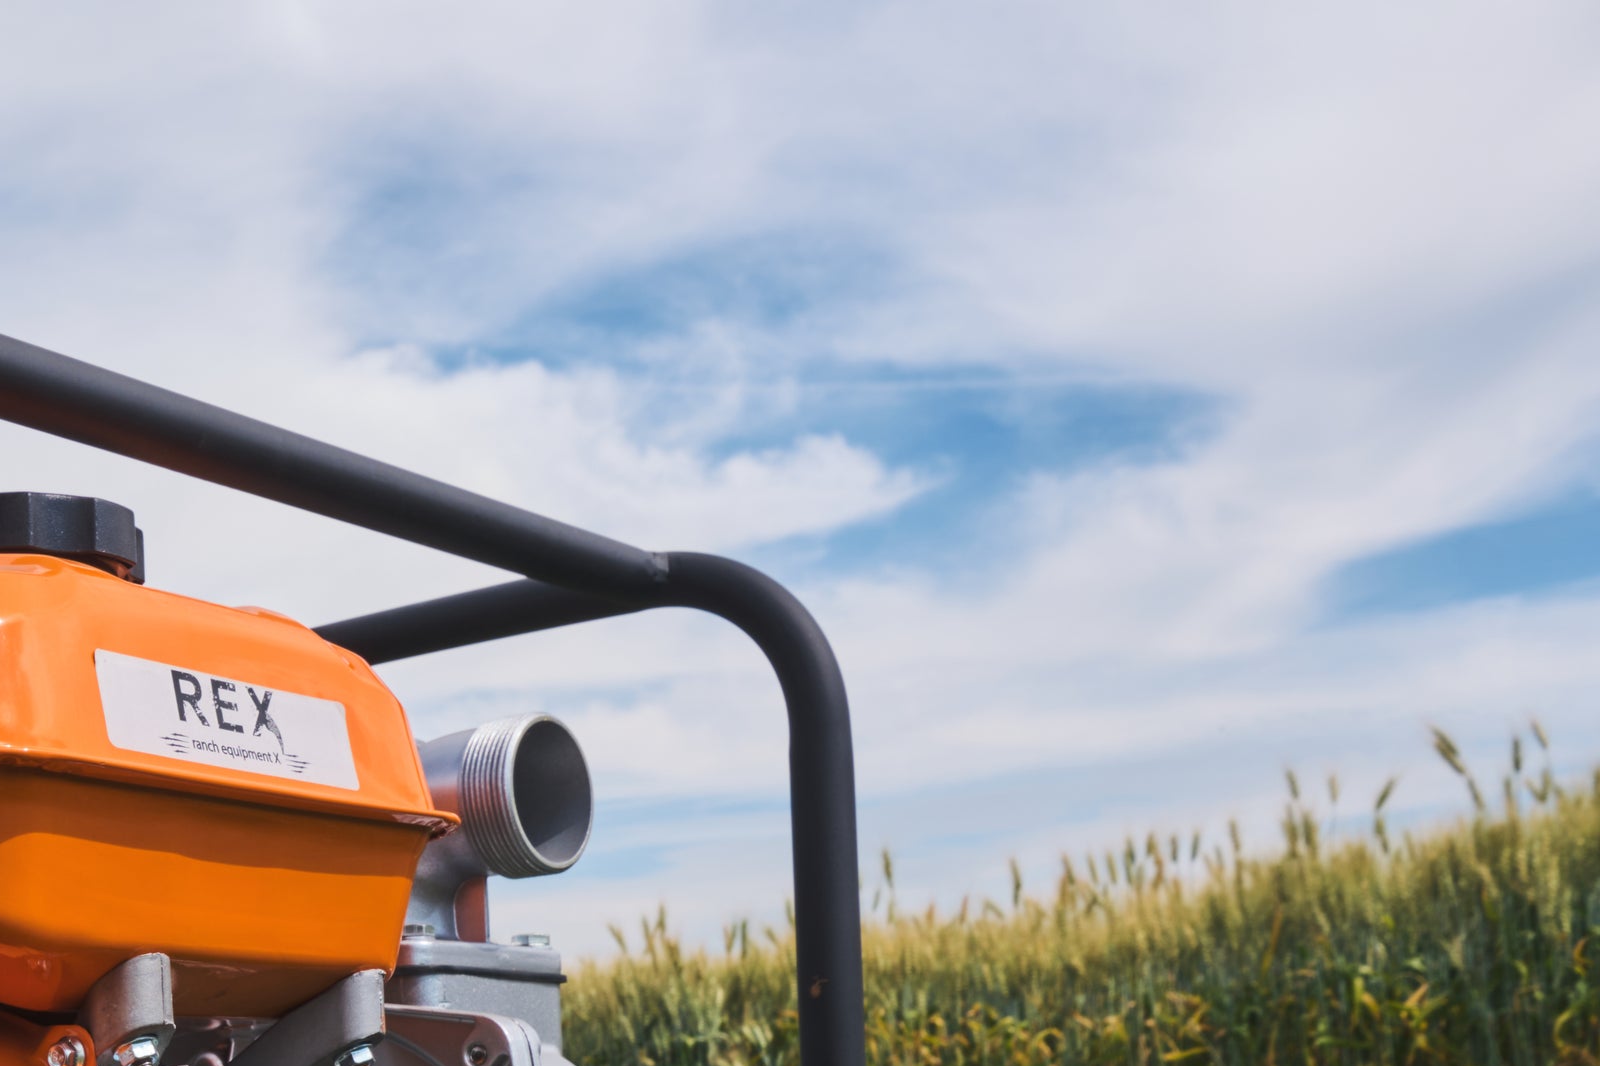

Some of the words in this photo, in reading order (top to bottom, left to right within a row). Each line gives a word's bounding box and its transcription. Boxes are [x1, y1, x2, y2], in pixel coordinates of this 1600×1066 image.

[171, 669, 283, 747] REX
[192, 740, 219, 753] ranch
[222, 746, 272, 762] equipment
[272, 752, 281, 764] X
